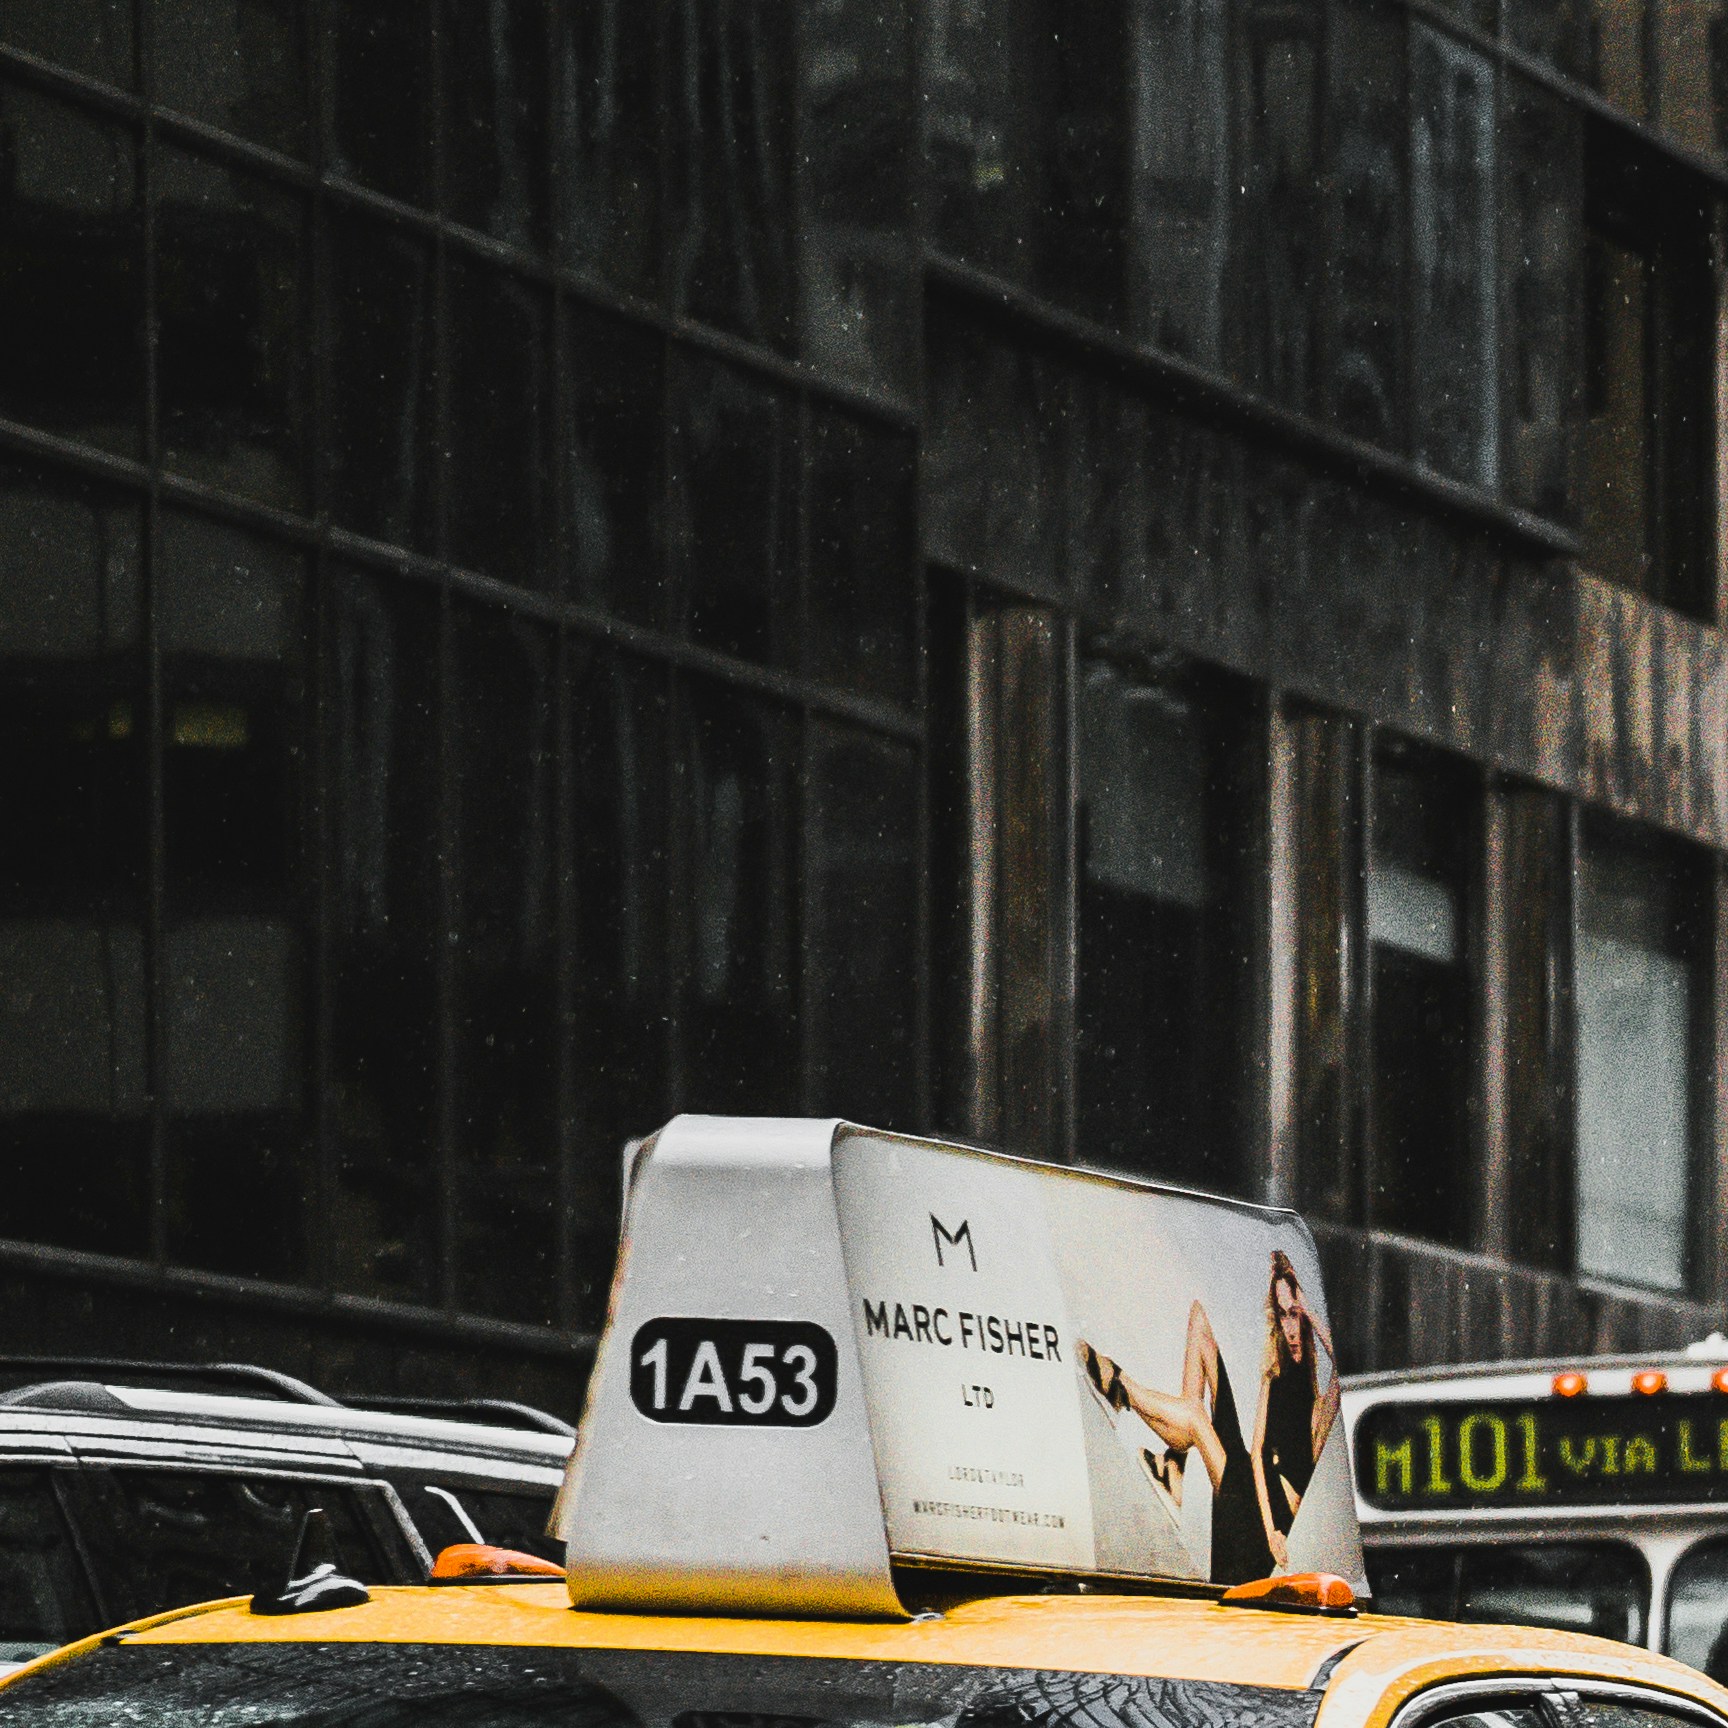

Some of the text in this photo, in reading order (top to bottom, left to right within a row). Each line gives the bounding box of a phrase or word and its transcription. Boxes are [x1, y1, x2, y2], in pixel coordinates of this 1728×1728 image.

[929, 1211, 978, 1273] M
[863, 1298, 1062, 1362] MARC FISHER
[640, 1338, 819, 1417] 1A53
[962, 1384, 995, 1409] LTD
[1374, 1412, 1549, 1497] M101
[1558, 1434, 1658, 1474] VIA
